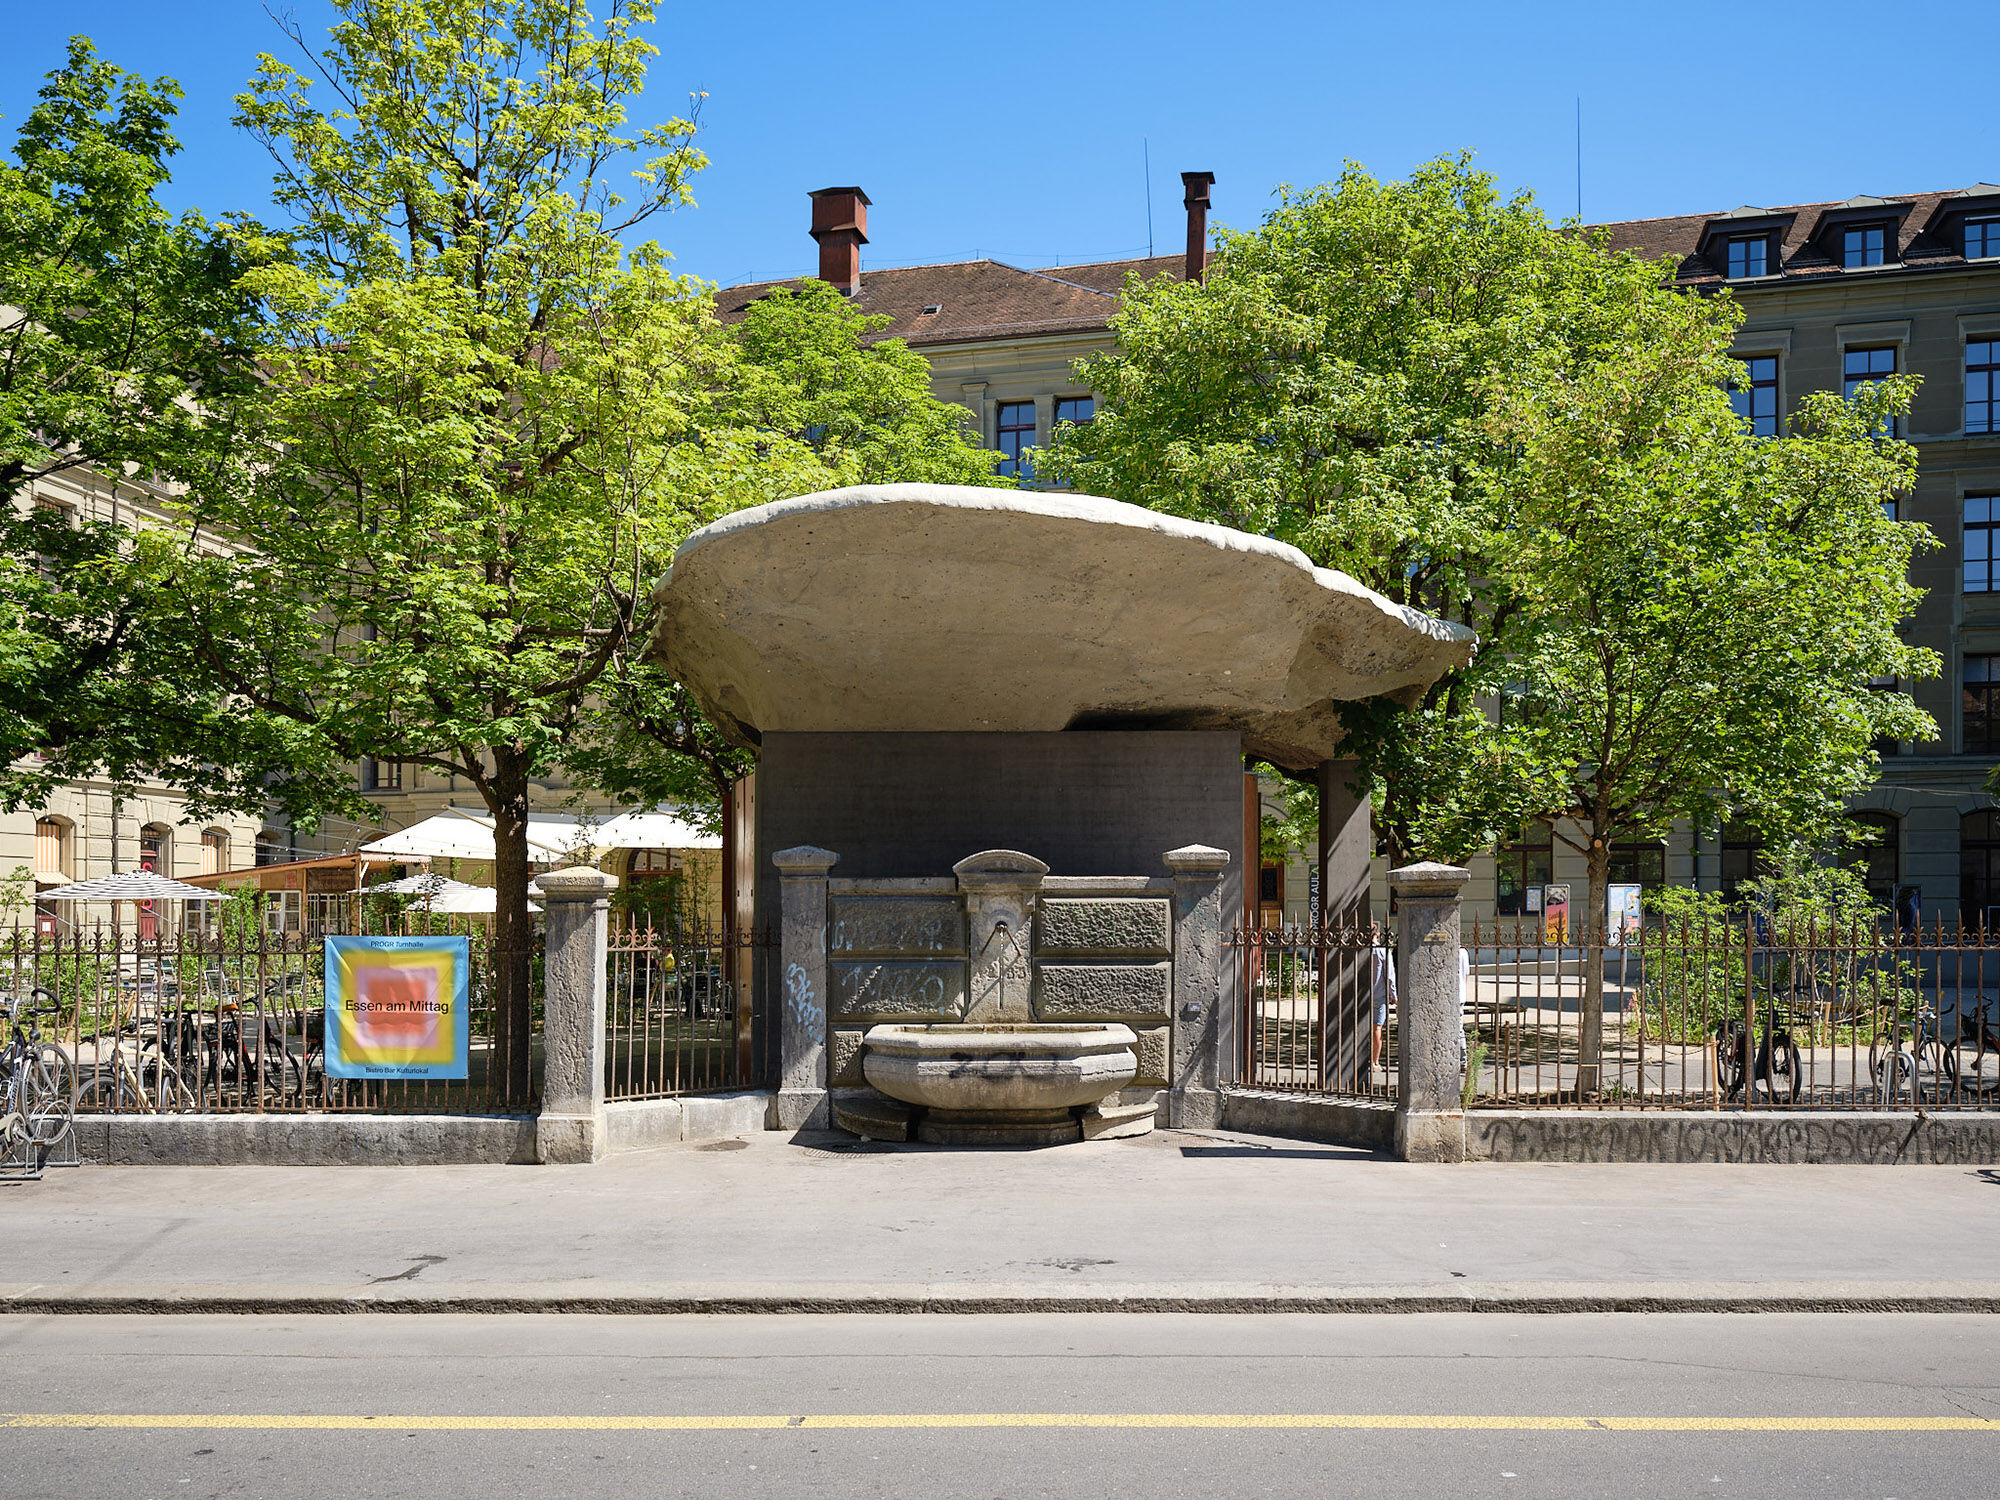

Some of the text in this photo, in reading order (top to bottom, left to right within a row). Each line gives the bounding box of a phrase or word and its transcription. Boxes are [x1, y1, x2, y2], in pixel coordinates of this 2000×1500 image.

[1310, 867, 1319, 930] PROGR AULA
[370, 940, 394, 948] PROGR
[345, 1000, 449, 1015] Essen am Mittag
